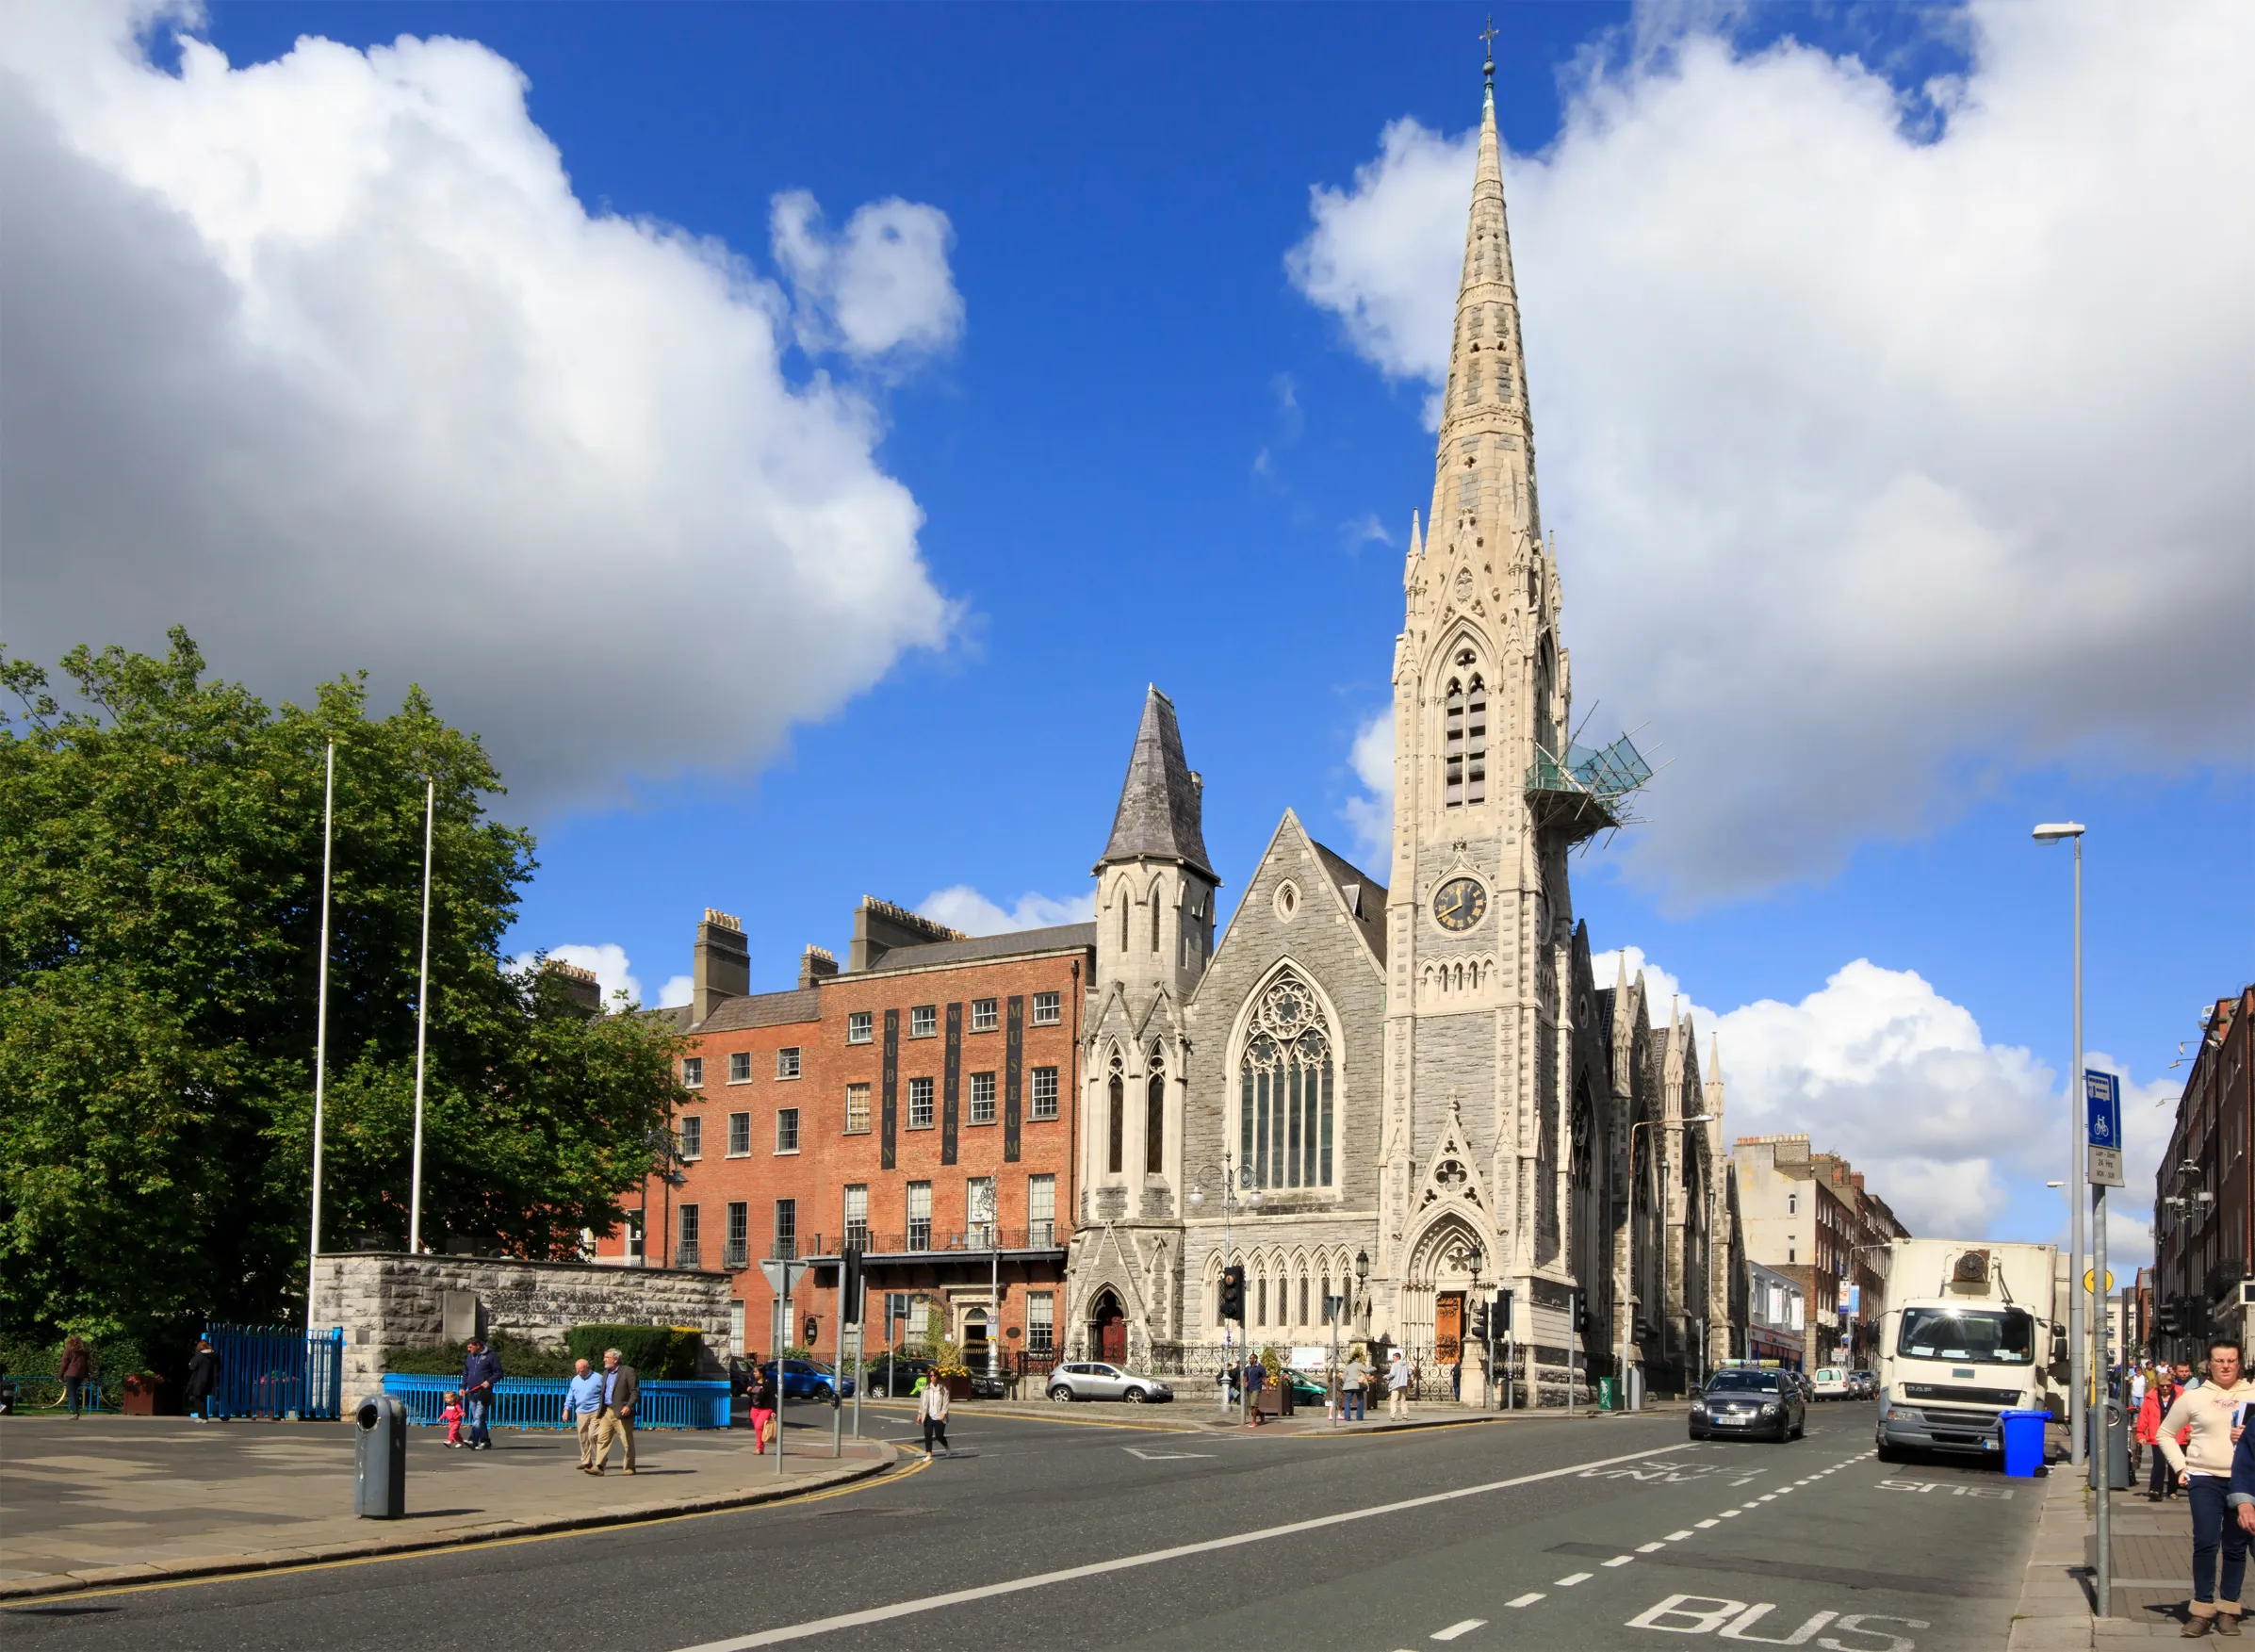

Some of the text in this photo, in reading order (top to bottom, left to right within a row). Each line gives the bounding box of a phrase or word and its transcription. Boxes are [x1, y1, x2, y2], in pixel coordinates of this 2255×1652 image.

[883, 1016, 896, 1161] DUBLIN
[946, 1010, 961, 1158] WRITERS
[1006, 1003, 1021, 1155] MUSEUM
[2098, 1158, 2114, 1169] 24 Hrs
[1874, 1480, 2015, 1500] BUS
[1625, 1594, 1931, 1652] BUS
